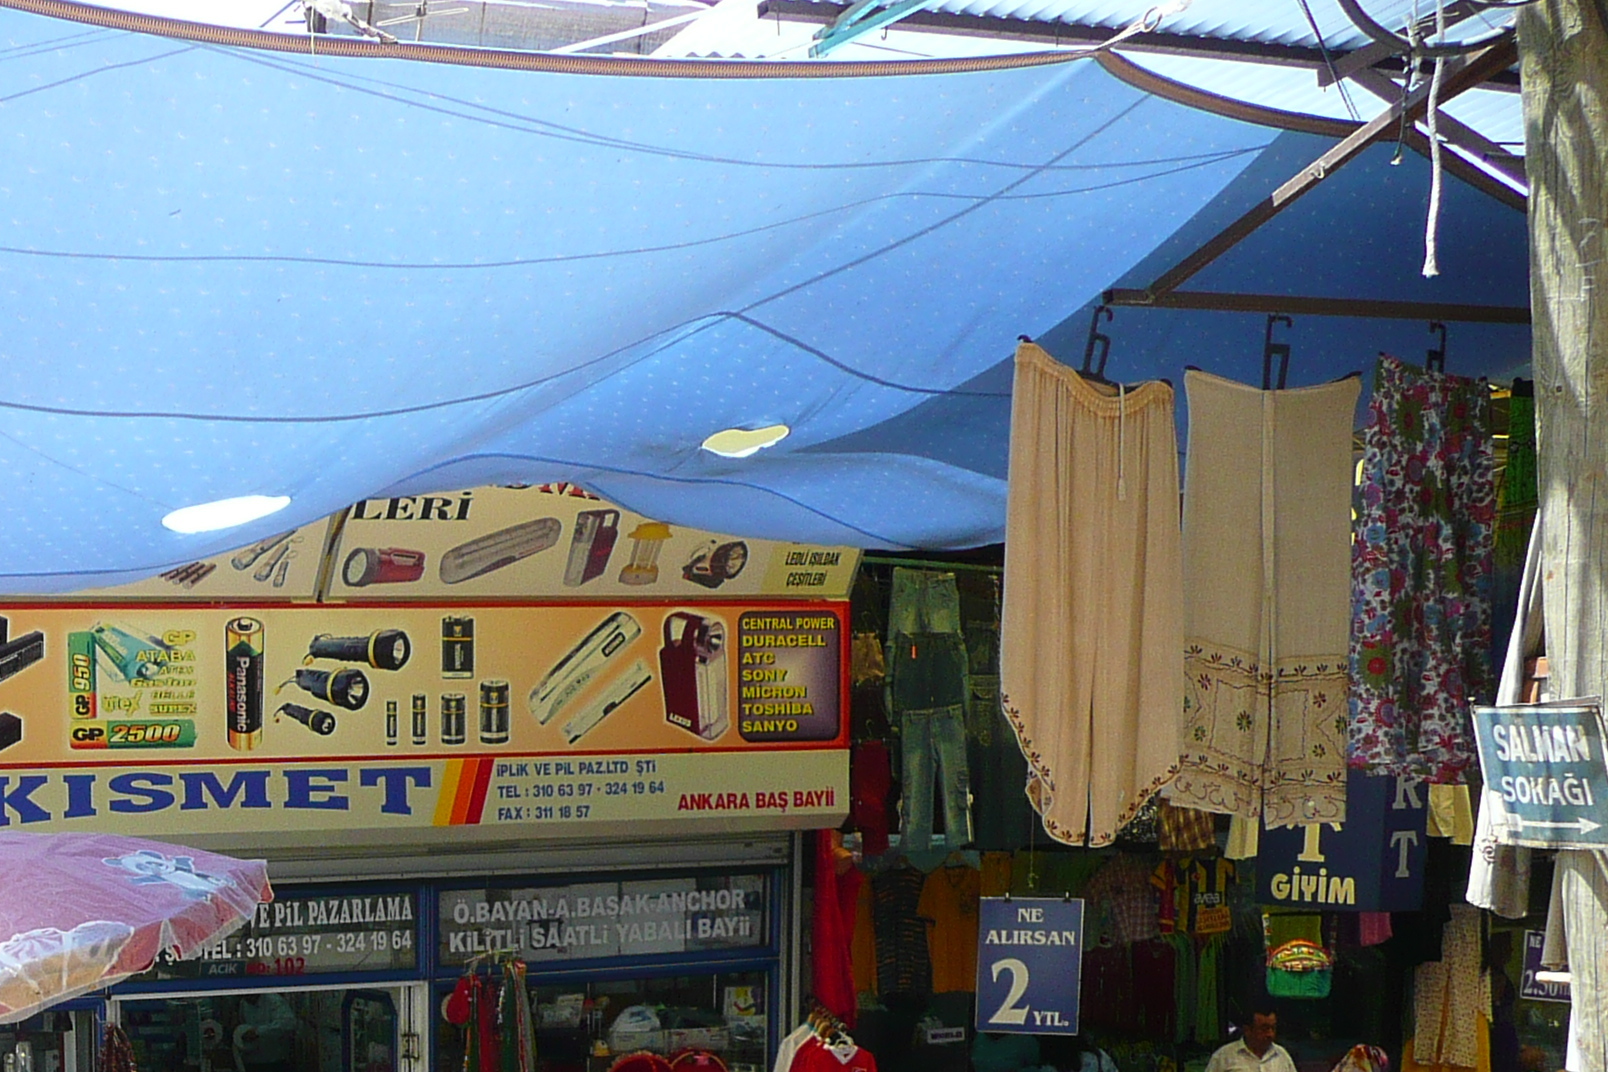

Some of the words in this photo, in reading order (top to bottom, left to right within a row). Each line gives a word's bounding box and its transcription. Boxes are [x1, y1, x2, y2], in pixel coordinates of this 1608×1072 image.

[742, 617, 793, 630] CENTRAL
[796, 617, 834, 629] POWER
[162, 630, 196, 646] GP
[742, 635, 826, 647] DURACELL
[136, 651, 196, 662] ATABA
[74, 654, 89, 691] 950
[742, 669, 787, 681] SONY
[236, 656, 249, 732] Panasonic
[75, 695, 89, 715] GP
[73, 728, 104, 741] GP
[110, 724, 181, 743] 2500
[742, 721, 798, 732] SANYO
[1494, 725, 1590, 762] SALMAN
[534, 763, 551, 775] VE
[555, 761, 574, 775] PİL
[498, 786, 520, 798] TEL
[533, 785, 553, 797] 310
[558, 785, 574, 797] 63
[578, 784, 592, 796] 97
[605, 782, 627, 795] 324
[631, 782, 645, 794] 19
[649, 781, 664, 793] 64
[1502, 773, 1594, 805] SOKAĞI
[678, 792, 749, 811] ANKARA
[755, 791, 788, 813] BAŞ
[498, 807, 523, 820] FAX
[535, 806, 553, 819] 311
[558, 806, 572, 818] 18
[576, 805, 590, 818] 57
[1271, 866, 1355, 905] GİYİM
[308, 896, 412, 924] PAZARLAMA
[1018, 909, 1043, 922] NE
[616, 920, 690, 943] YABALI
[985, 930, 1074, 945] ALIRSAN
[247, 939, 271, 957] 310
[278, 937, 296, 955] 63
[303, 936, 321, 954] 97
[337, 934, 365, 951] 324
[371, 932, 385, 949] 19
[392, 930, 411, 949] 64
[1530, 936, 1542, 948] NE
[275, 958, 305, 974] 102
[988, 958, 1029, 1025] 2
